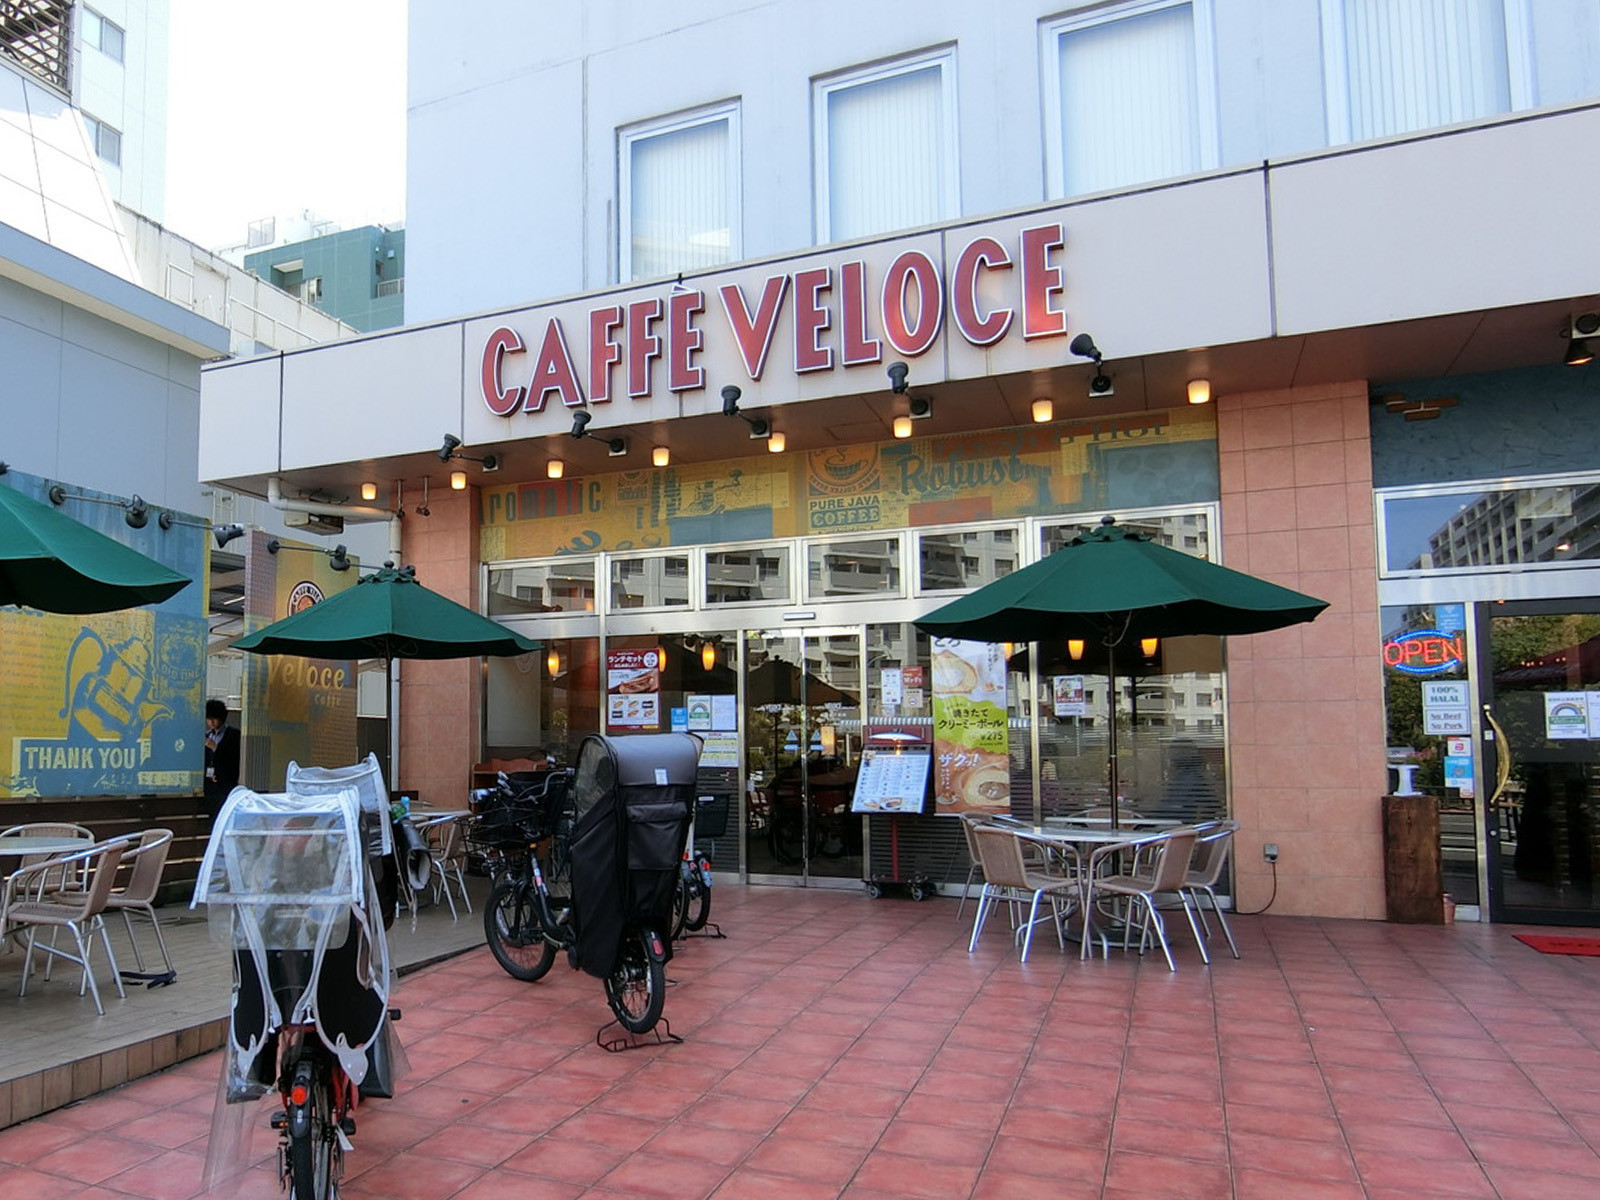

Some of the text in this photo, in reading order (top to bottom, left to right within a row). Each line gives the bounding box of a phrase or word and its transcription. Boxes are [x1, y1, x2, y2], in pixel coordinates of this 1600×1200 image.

[480, 222, 1069, 417] CAFFÈ VELOCE
[897, 438, 1023, 496] Robust
[478, 479, 602, 525] romatic
[810, 495, 880, 510] PURE JAVA
[812, 508, 879, 526] COFFEE
[1383, 638, 1463, 666] OPEN
[266, 654, 345, 690] Veloce
[1430, 695, 1461, 703] HALAL
[1431, 686, 1459, 694] 100%
[1444, 722, 1463, 730] Pork
[25, 746, 136, 770] THANK YOU
